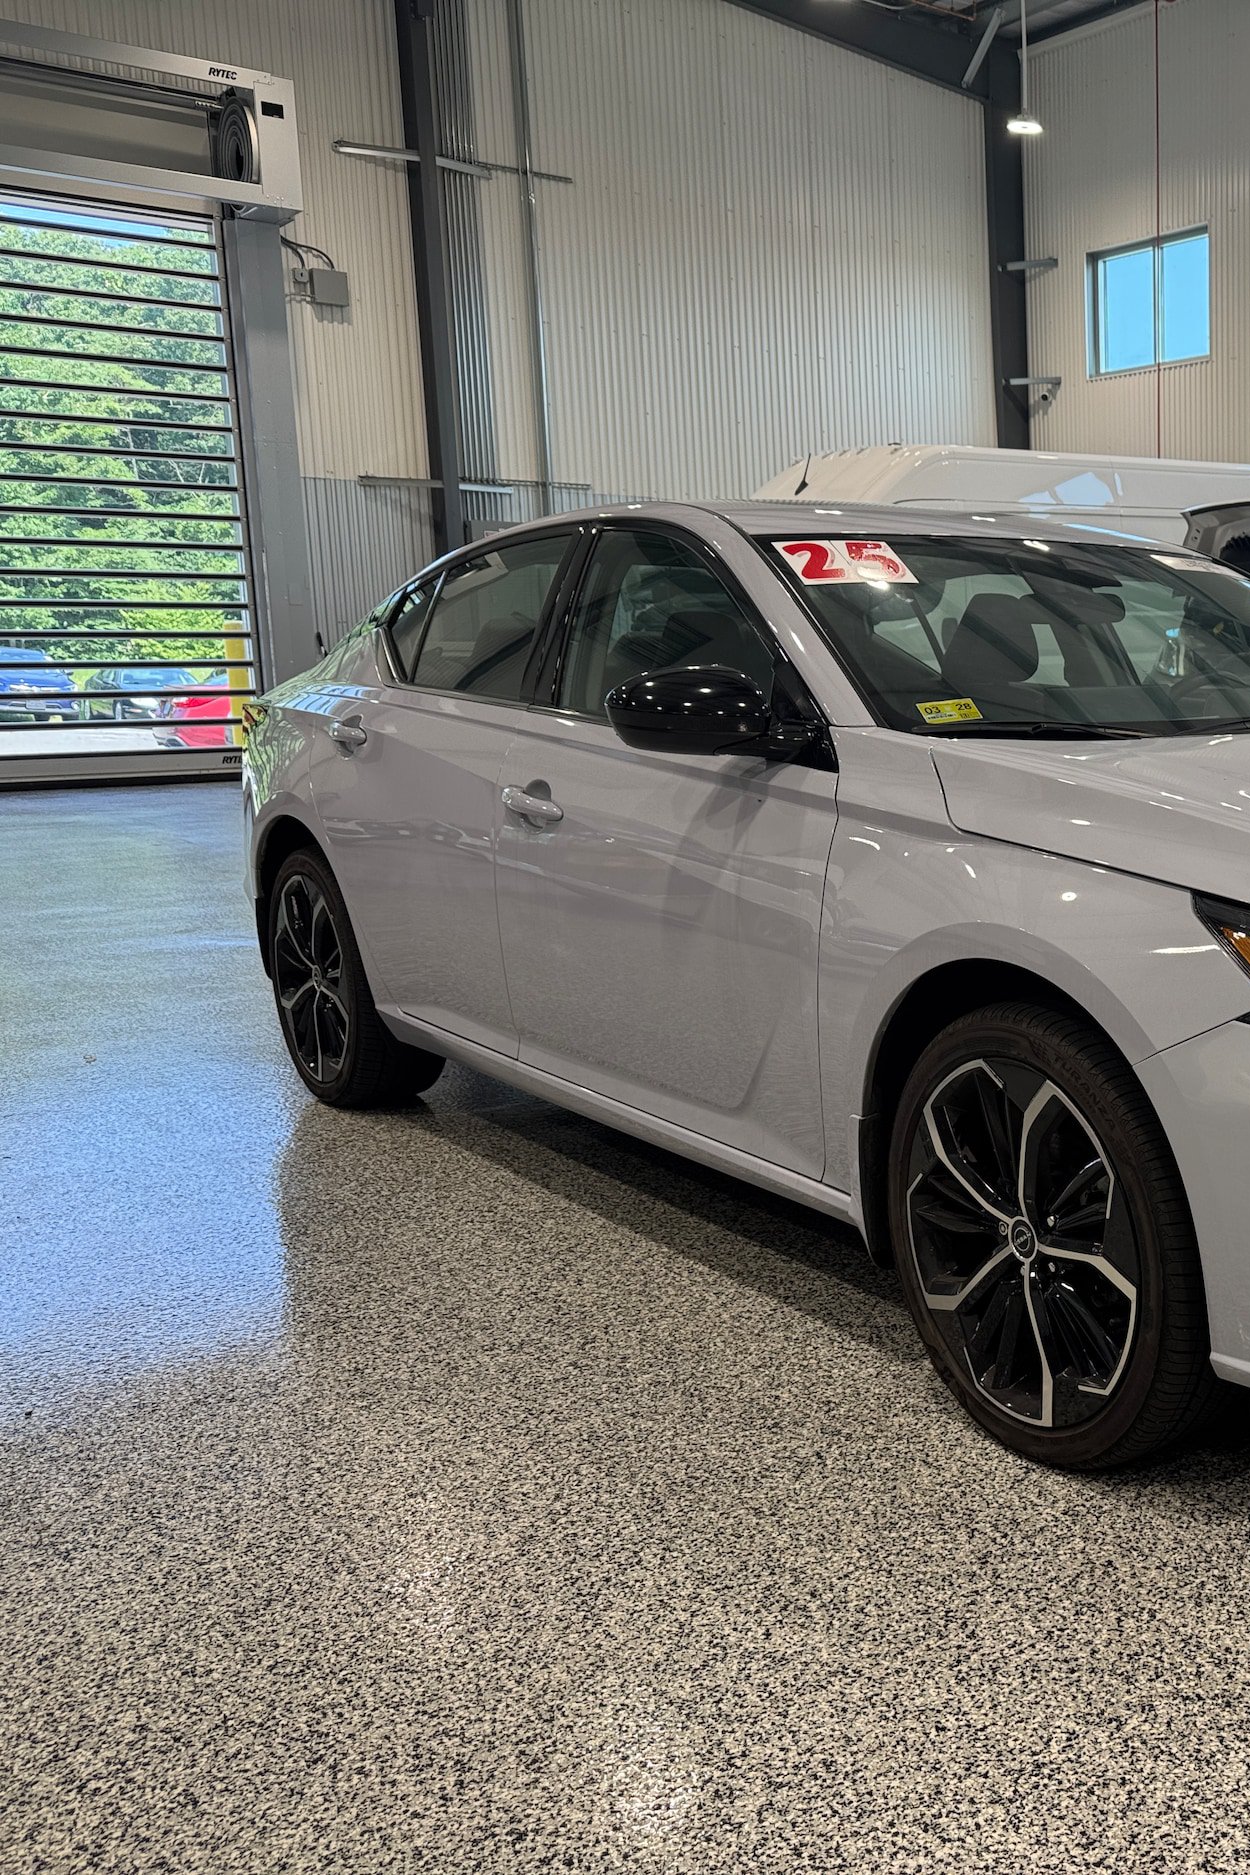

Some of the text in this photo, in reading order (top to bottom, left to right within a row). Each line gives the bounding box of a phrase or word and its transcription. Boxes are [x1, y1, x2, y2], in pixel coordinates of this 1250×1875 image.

[208, 67, 238, 80] RYTEC
[782, 542, 902, 580] 25
[924, 703, 972, 714] 03 28
[222, 755, 242, 764] RYTE
[1054, 1052, 1117, 1131] TURANZA
